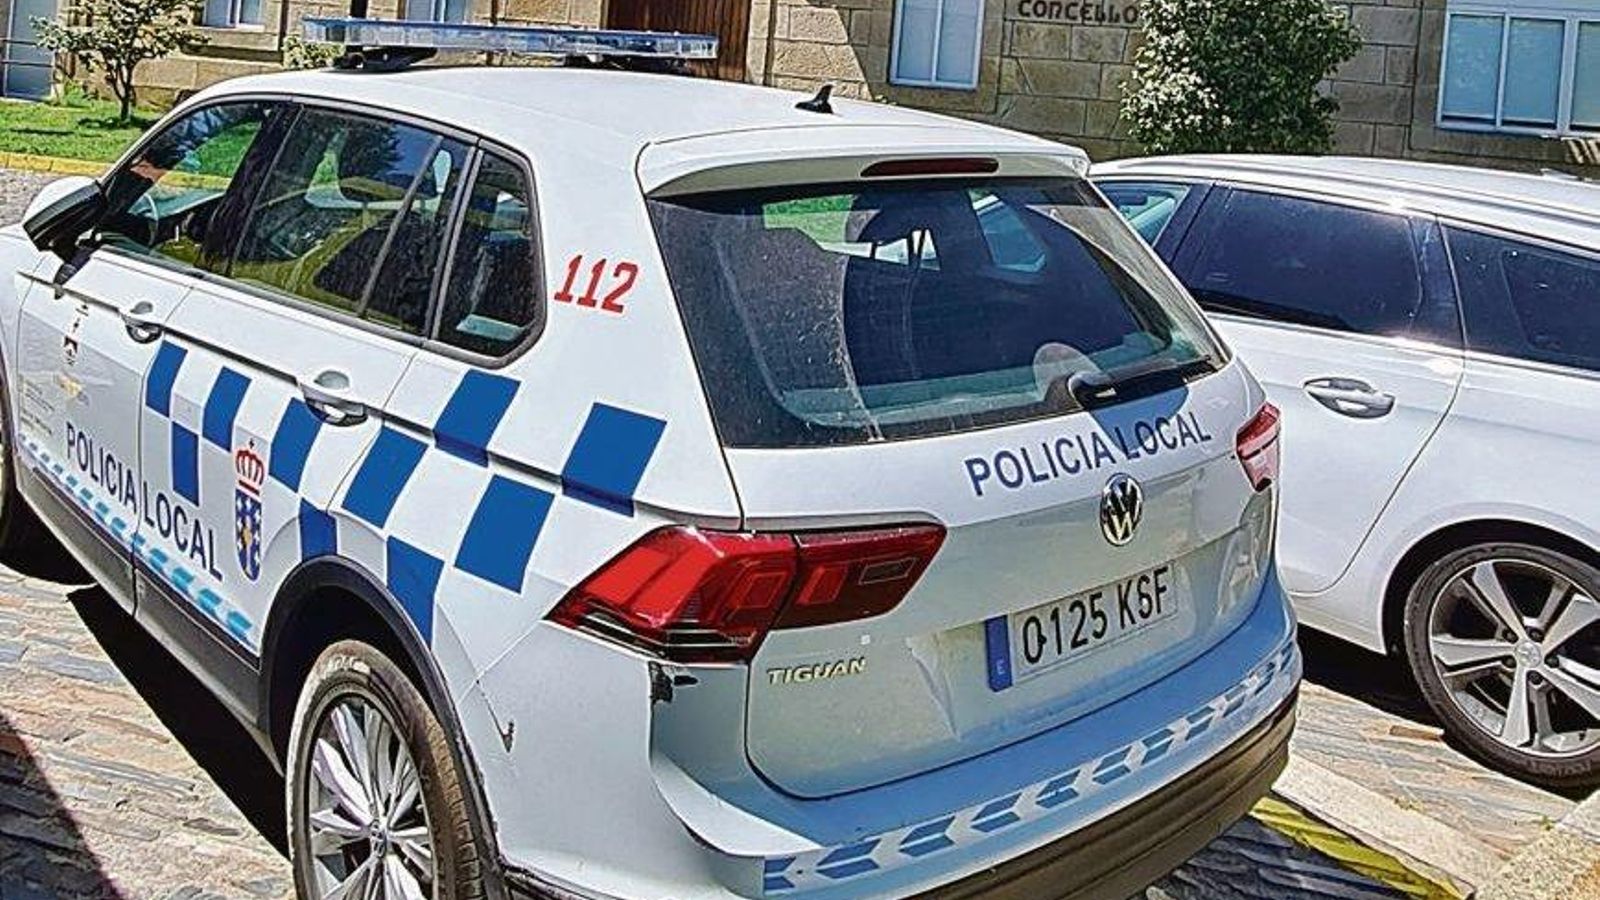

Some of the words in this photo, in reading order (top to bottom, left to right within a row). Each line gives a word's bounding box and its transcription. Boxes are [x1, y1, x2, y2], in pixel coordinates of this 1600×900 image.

[554, 254, 638, 314] 112
[965, 432, 1116, 496] POLICIA
[1115, 411, 1211, 459] LOCAL
[66, 421, 137, 515] POLICIA
[143, 481, 223, 582] LOCAL
[1022, 592, 1108, 664] 0125
[1117, 566, 1168, 630] KSF
[766, 656, 866, 685] TIGUAN
